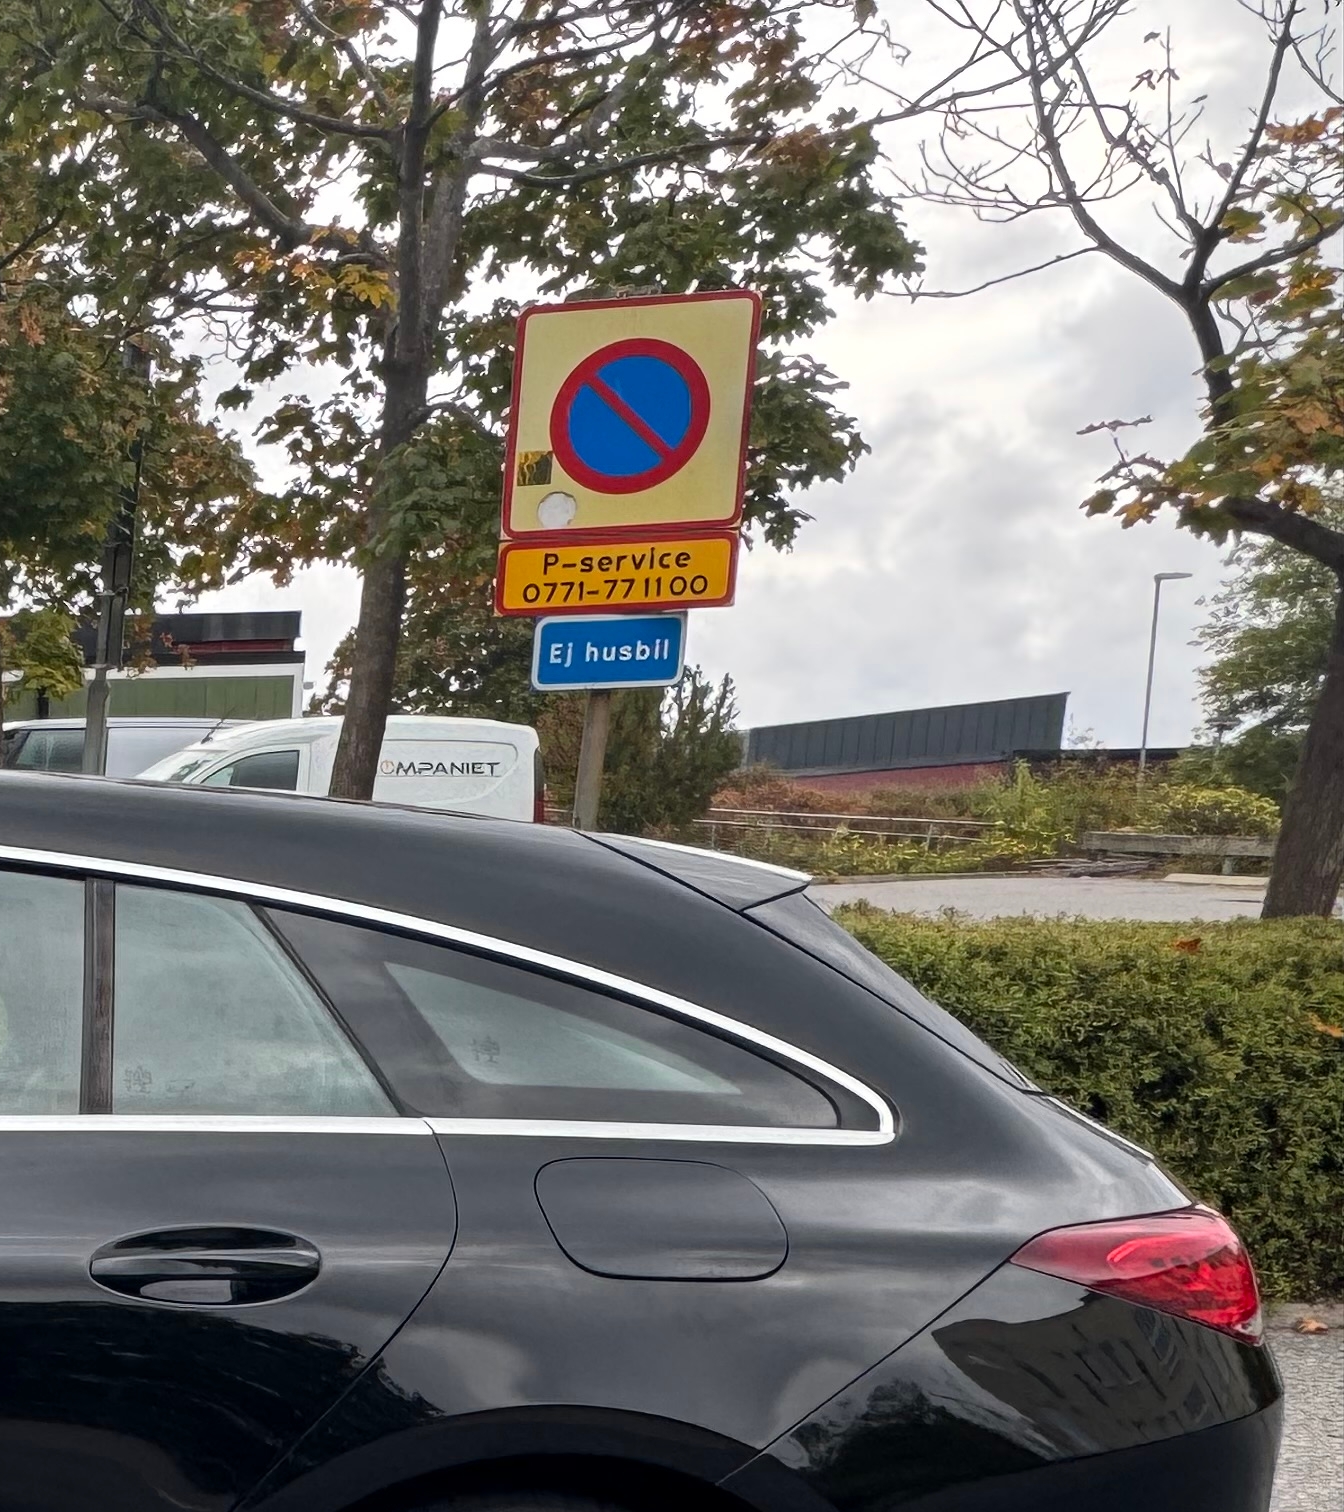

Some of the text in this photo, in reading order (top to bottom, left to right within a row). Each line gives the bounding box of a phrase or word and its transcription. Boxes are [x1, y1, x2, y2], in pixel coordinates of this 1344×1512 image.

[543, 547, 691, 575] P-service
[549, 639, 670, 667] Ej husbil
